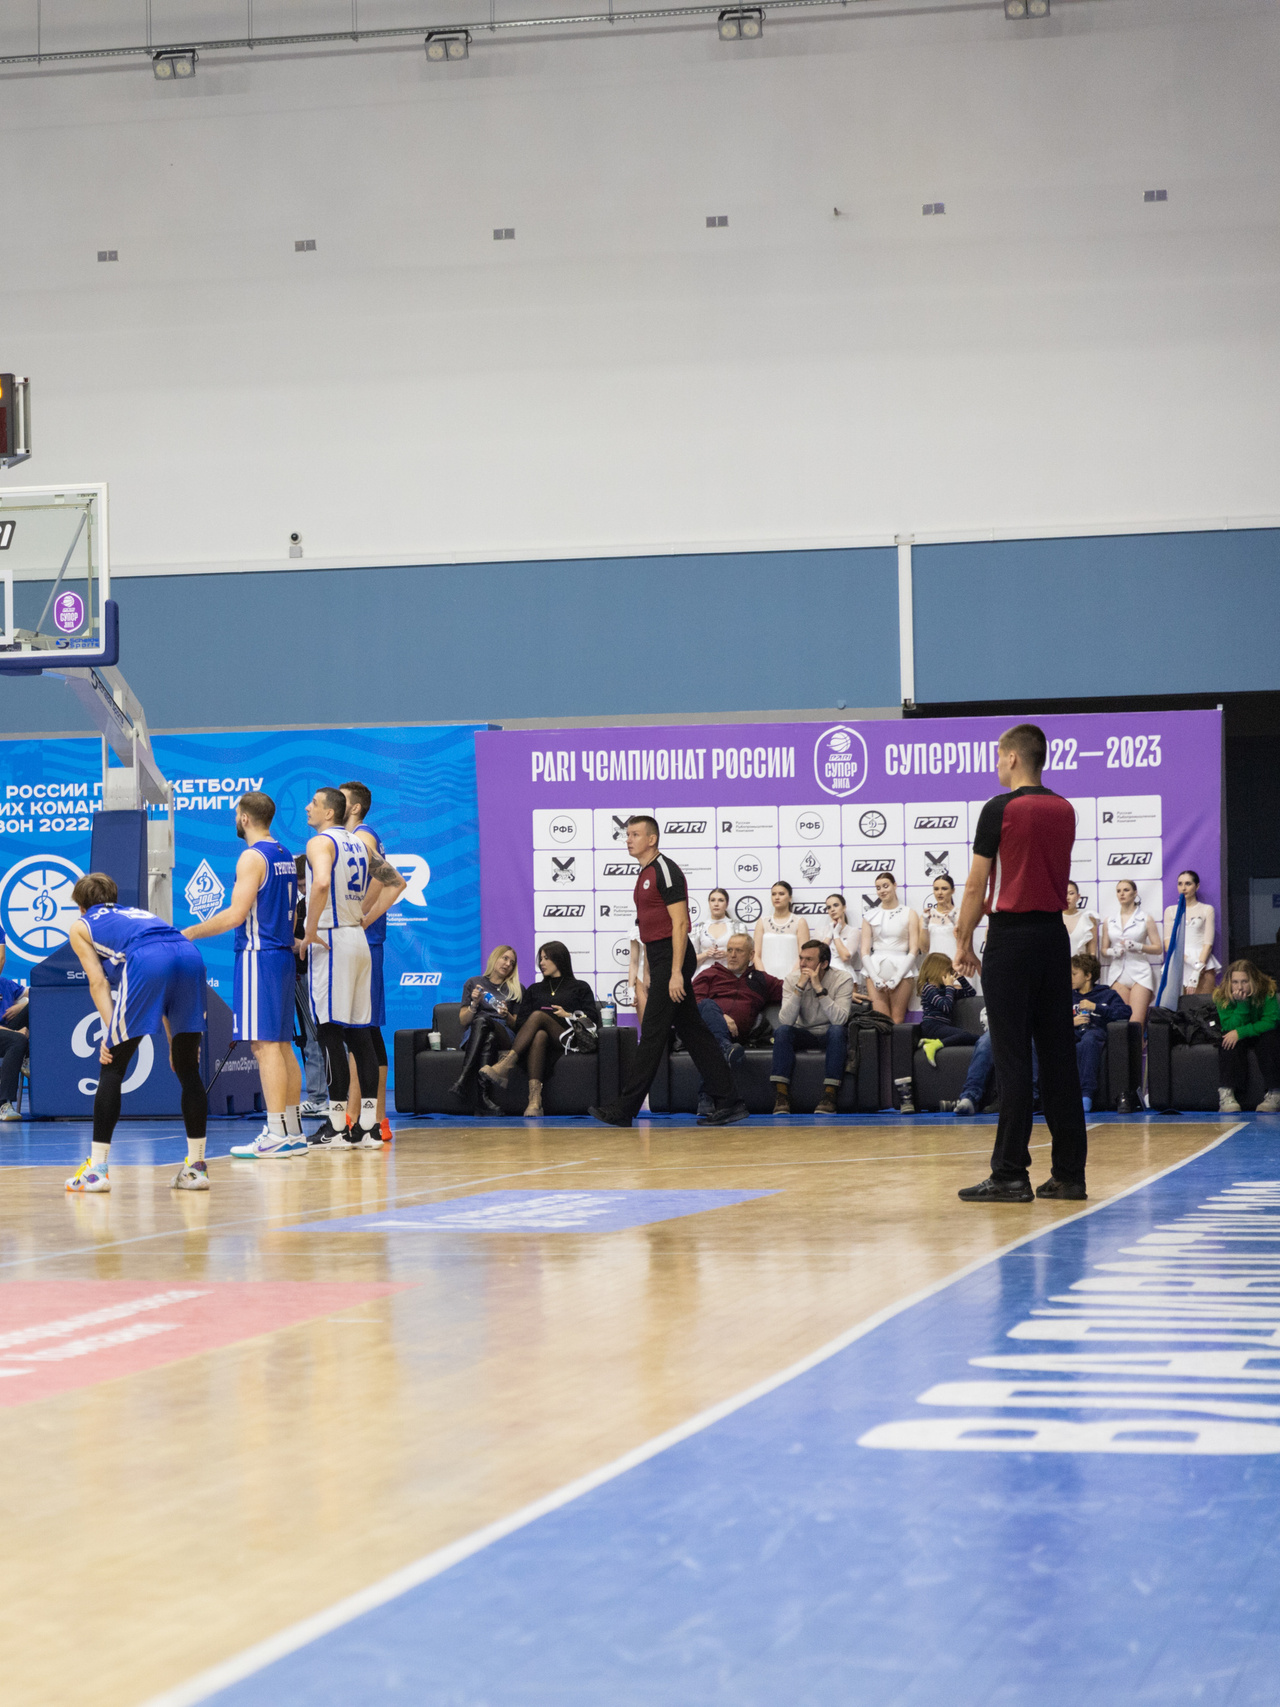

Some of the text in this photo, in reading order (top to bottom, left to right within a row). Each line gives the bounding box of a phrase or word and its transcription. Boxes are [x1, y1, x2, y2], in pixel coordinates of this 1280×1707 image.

[531, 751, 576, 782] PARI
[712, 747, 795, 779] РОССИИ
[885, 741, 999, 776] СУПЕРЛИГ
[825, 762, 857, 778] СУПЕР
[6, 783, 88, 800] РОССИИ
[31, 800, 103, 816] КОМАН
[553, 825, 574, 833] РФБ
[664, 821, 707, 834] PARI
[799, 821, 821, 829] РФБ
[914, 816, 958, 829] PARI
[852, 859, 896, 872] PARI
[1108, 852, 1152, 866] PARI
[346, 857, 368, 892] 21
[738, 864, 759, 872] РФБ
[543, 904, 586, 917] PARI
[616, 948, 630, 956] РФ
[401, 974, 440, 984] PARI
